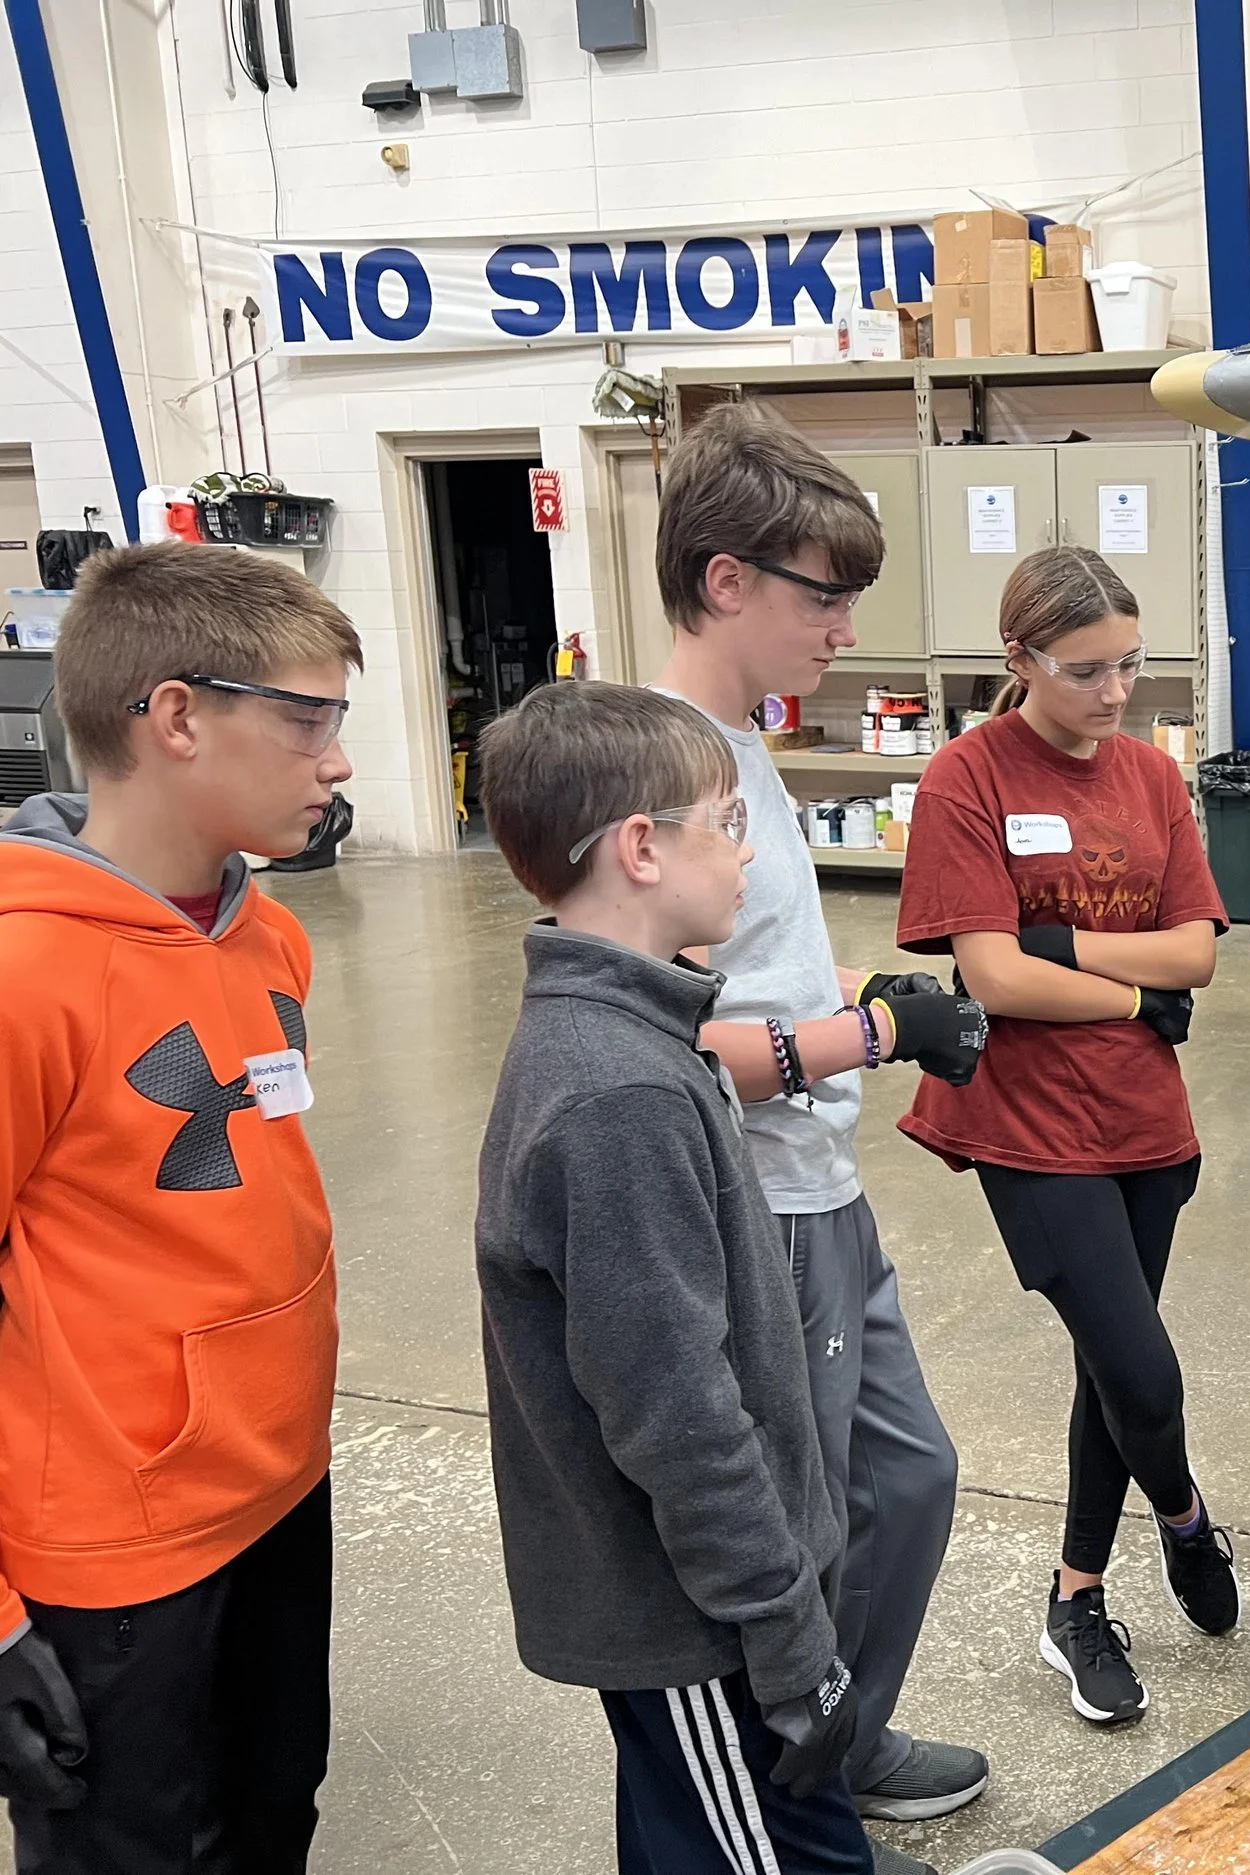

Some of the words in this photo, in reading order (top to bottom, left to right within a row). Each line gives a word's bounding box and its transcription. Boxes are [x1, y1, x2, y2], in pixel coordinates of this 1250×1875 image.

[274, 247, 433, 342] NO
[485, 222, 1056, 334] SMOKIN
[252, 1062, 297, 1078] Workshops
